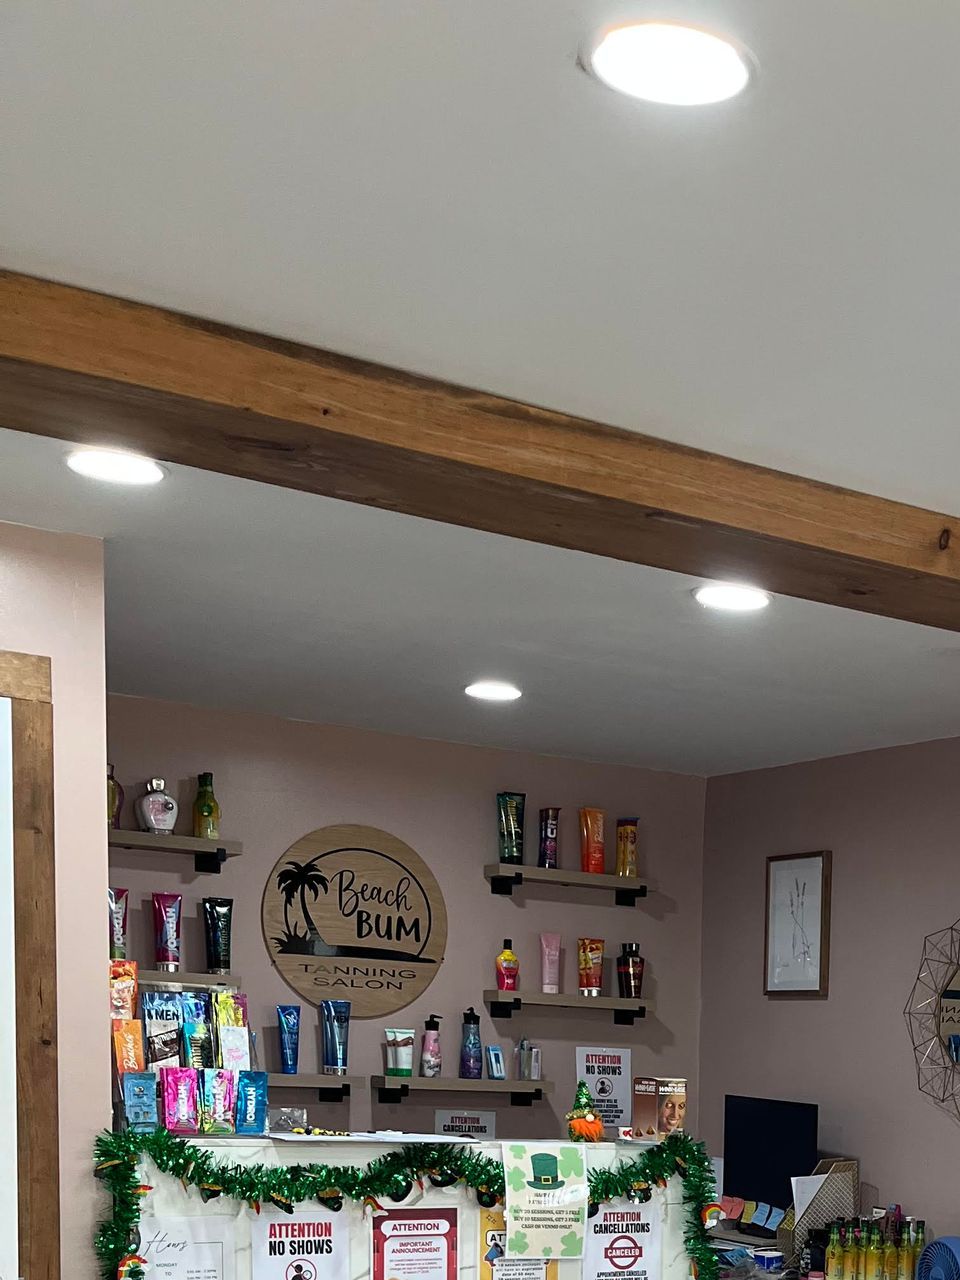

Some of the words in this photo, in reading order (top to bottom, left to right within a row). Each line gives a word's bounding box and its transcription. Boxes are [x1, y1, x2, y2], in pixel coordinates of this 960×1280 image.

[330, 869, 412, 917] Beach
[166, 906, 177, 949] HYDRO
[357, 910, 420, 942] BUM
[298, 964, 416, 979] TANNING
[313, 977, 402, 990] SALON
[585, 1054, 622, 1065] ATTENTION
[585, 1065, 596, 1075] NO
[597, 1065, 622, 1076] SHOWS
[178, 1085, 187, 1120] HYDRO
[247, 1086, 256, 1121] HYDRO
[451, 1116, 480, 1125] ATTENTION
[443, 1124, 487, 1133] CANCELLATIONS
[603, 1212, 641, 1223] ATTENTION
[269, 1222, 332, 1239] ATTENTION
[392, 1223, 439, 1231] ATTENTION
[593, 1223, 650, 1234] CANCELLATIONS
[144, 1230, 188, 1256] Hours
[269, 1240, 285, 1256] NO
[289, 1239, 333, 1255] SHOWS
[607, 1249, 640, 1257] CANCELED
